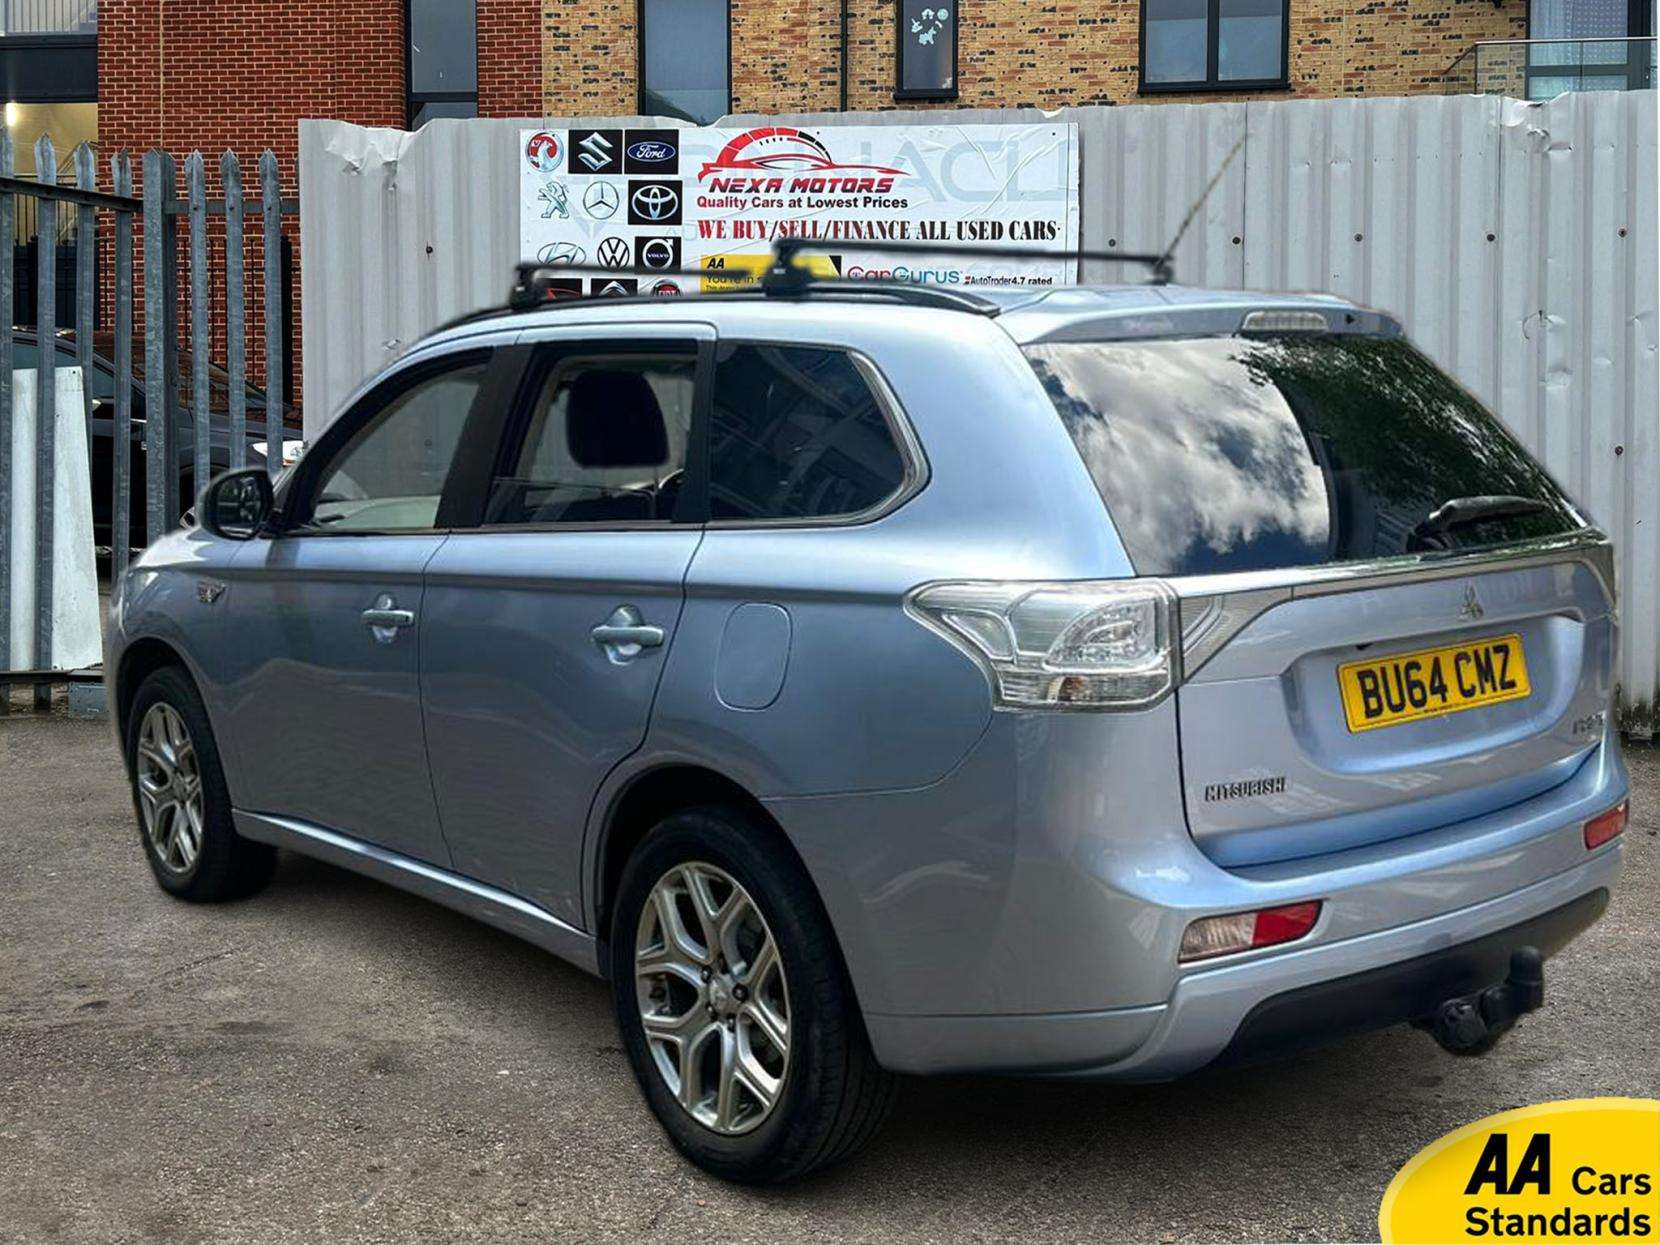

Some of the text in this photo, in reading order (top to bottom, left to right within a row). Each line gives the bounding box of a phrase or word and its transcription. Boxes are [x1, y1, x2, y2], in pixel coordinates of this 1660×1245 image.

[635, 143, 666, 159] Ford
[708, 177, 895, 194] NEXA MOTORS
[696, 195, 909, 211] Quality Cars at Lowest Prices
[697, 219, 727, 240] WE
[916, 219, 952, 241] ALL
[956, 219, 1004, 241] USED
[1008, 219, 1057, 241] CARS
[706, 257, 725, 269] AA
[847, 266, 961, 284] CarGurus
[1027, 276, 1053, 286] rated
[1356, 644, 1517, 720] BU64 CMZ
